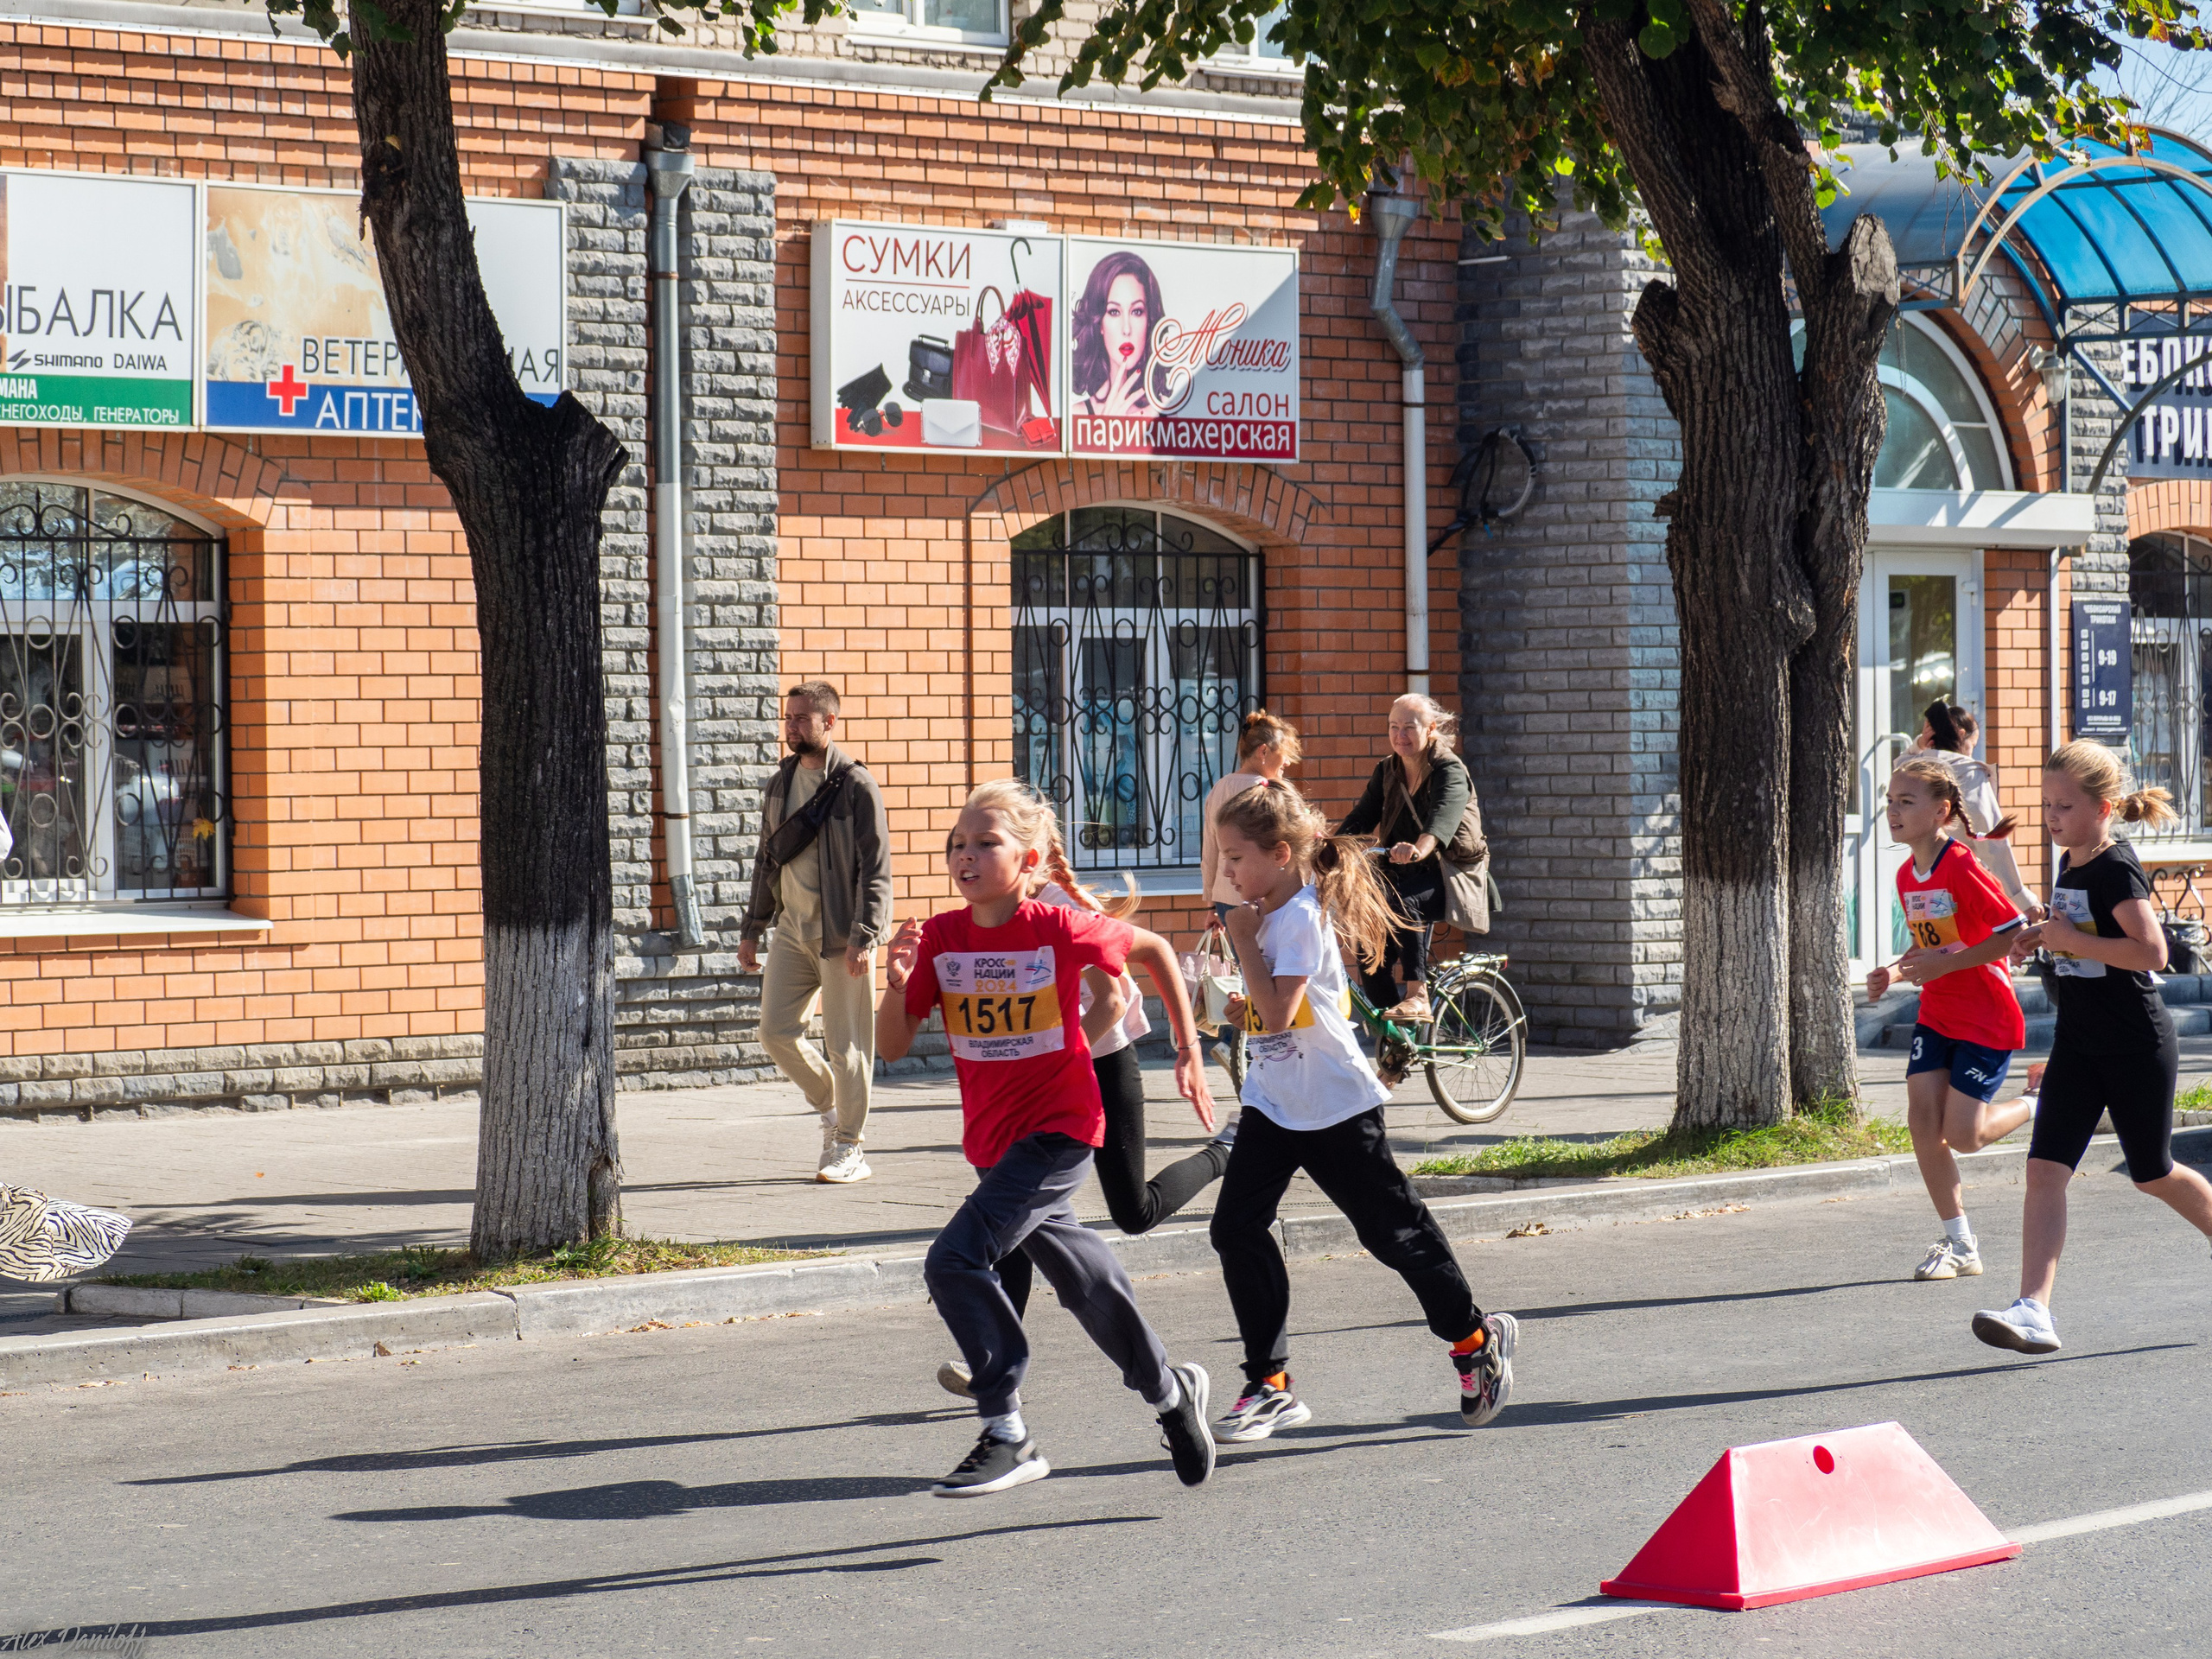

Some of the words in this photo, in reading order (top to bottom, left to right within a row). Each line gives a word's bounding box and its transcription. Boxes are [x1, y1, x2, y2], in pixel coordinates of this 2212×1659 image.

[842, 233, 970, 280] СУМКИ
[842, 289, 970, 316] АКСЕССУАРЫ
[35, 353, 103, 368] SHIMANO
[113, 353, 168, 371] DAIWA
[1147, 302, 1289, 410] Моника
[0, 403, 87, 423] НЕГОХОДЫ,
[93, 406, 180, 424] ГЕНЕРАТОРЫ
[1206, 391, 1289, 418] салон
[1077, 418, 1291, 455] парикмахерская
[2097, 649, 2117, 665] 9-19
[2098, 690, 2117, 706] 9-17
[1912, 921, 1941, 949] 68
[974, 957, 1006, 968] КРОСС
[974, 969, 1015, 979] НАЦИИ
[975, 979, 1017, 992] 2024
[958, 995, 1037, 1033] 1517
[969, 1036, 1034, 1048] ВЛАДИМИРСКАЯ
[1911, 1036, 1923, 1060] 3
[981, 1048, 1020, 1058] ОБЛАСТЬ
